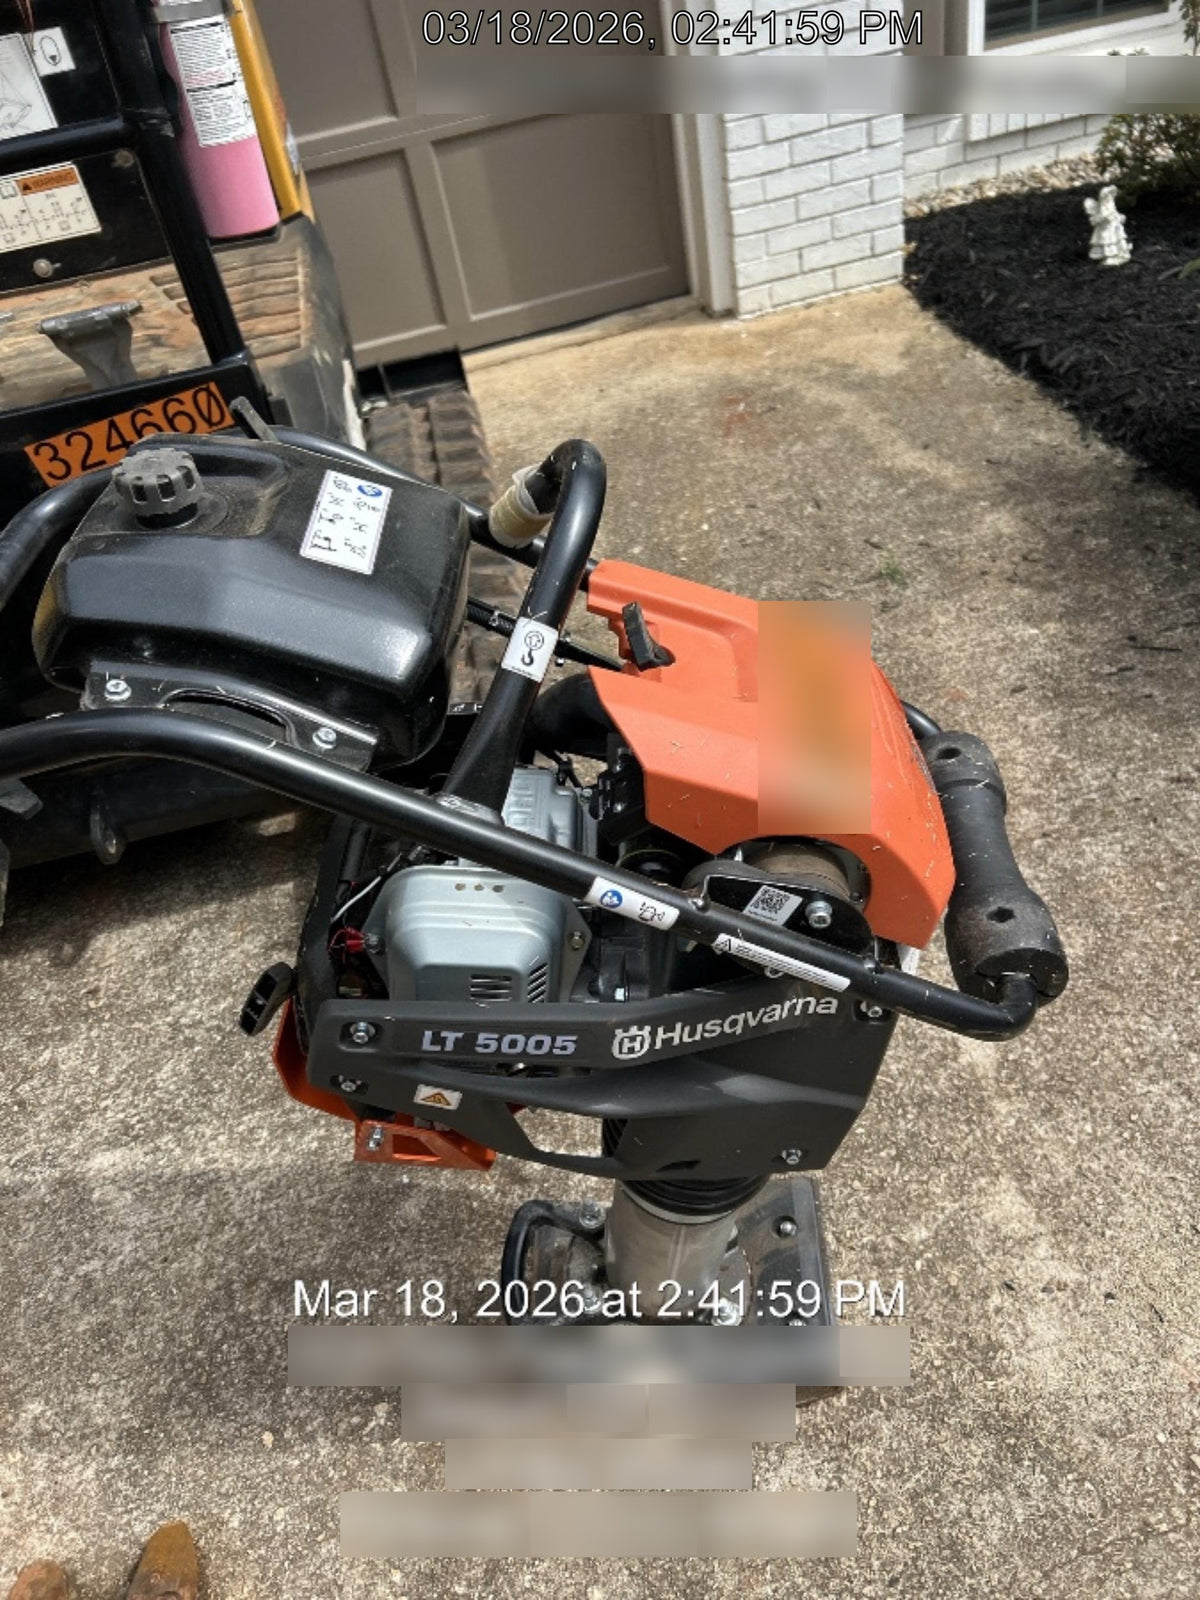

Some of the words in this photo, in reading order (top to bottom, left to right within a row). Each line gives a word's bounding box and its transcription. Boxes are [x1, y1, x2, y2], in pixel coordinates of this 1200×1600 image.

[421, 1030, 463, 1052] LT
[474, 1033, 579, 1056] 5005
[653, 995, 839, 1051] Husqvarna
